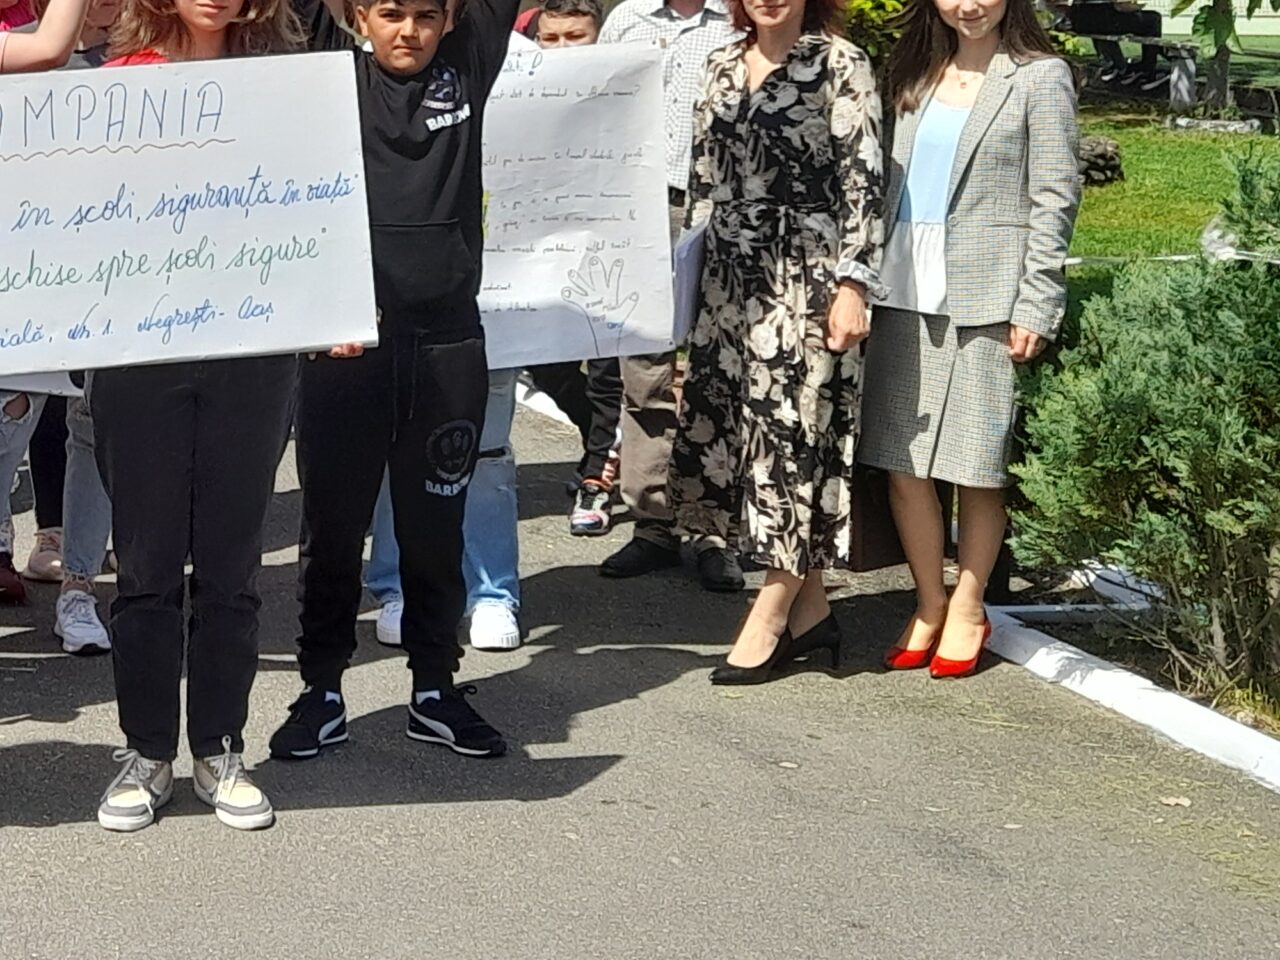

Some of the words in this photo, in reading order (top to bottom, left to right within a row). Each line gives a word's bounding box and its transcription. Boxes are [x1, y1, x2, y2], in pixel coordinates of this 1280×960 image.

[10, 200, 54, 232] în
[145, 165, 276, 234] siguranță
[278, 179, 302, 206] în
[86, 249, 151, 296] spre
[156, 235, 216, 285] școli
[237, 295, 275, 324] Oaș
